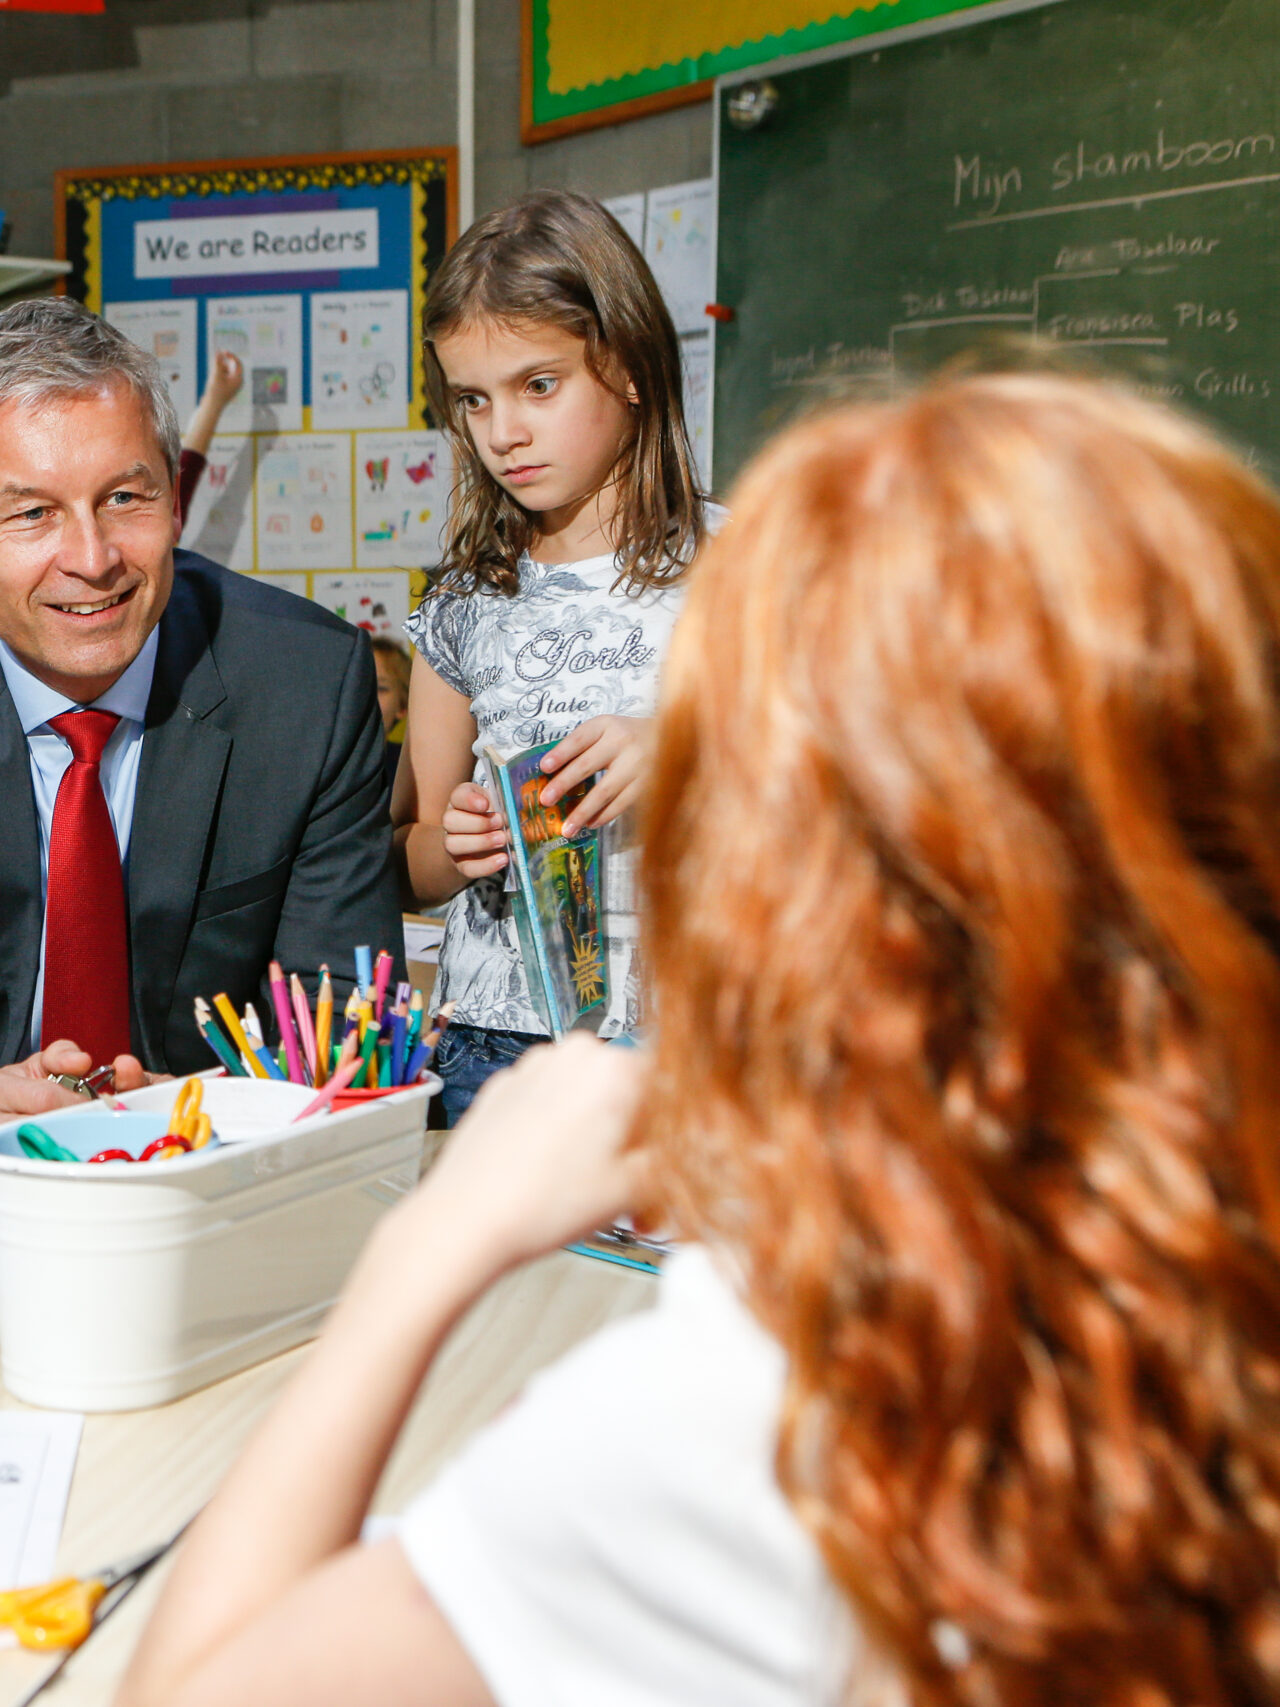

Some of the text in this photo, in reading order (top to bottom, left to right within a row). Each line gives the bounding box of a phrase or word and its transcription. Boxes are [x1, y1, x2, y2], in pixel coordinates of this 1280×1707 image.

[954, 128, 1276, 215] Mijn stamboom
[144, 226, 368, 262] We are Readers
[514, 627, 658, 683] York
[480, 688, 593, 734] pire State
